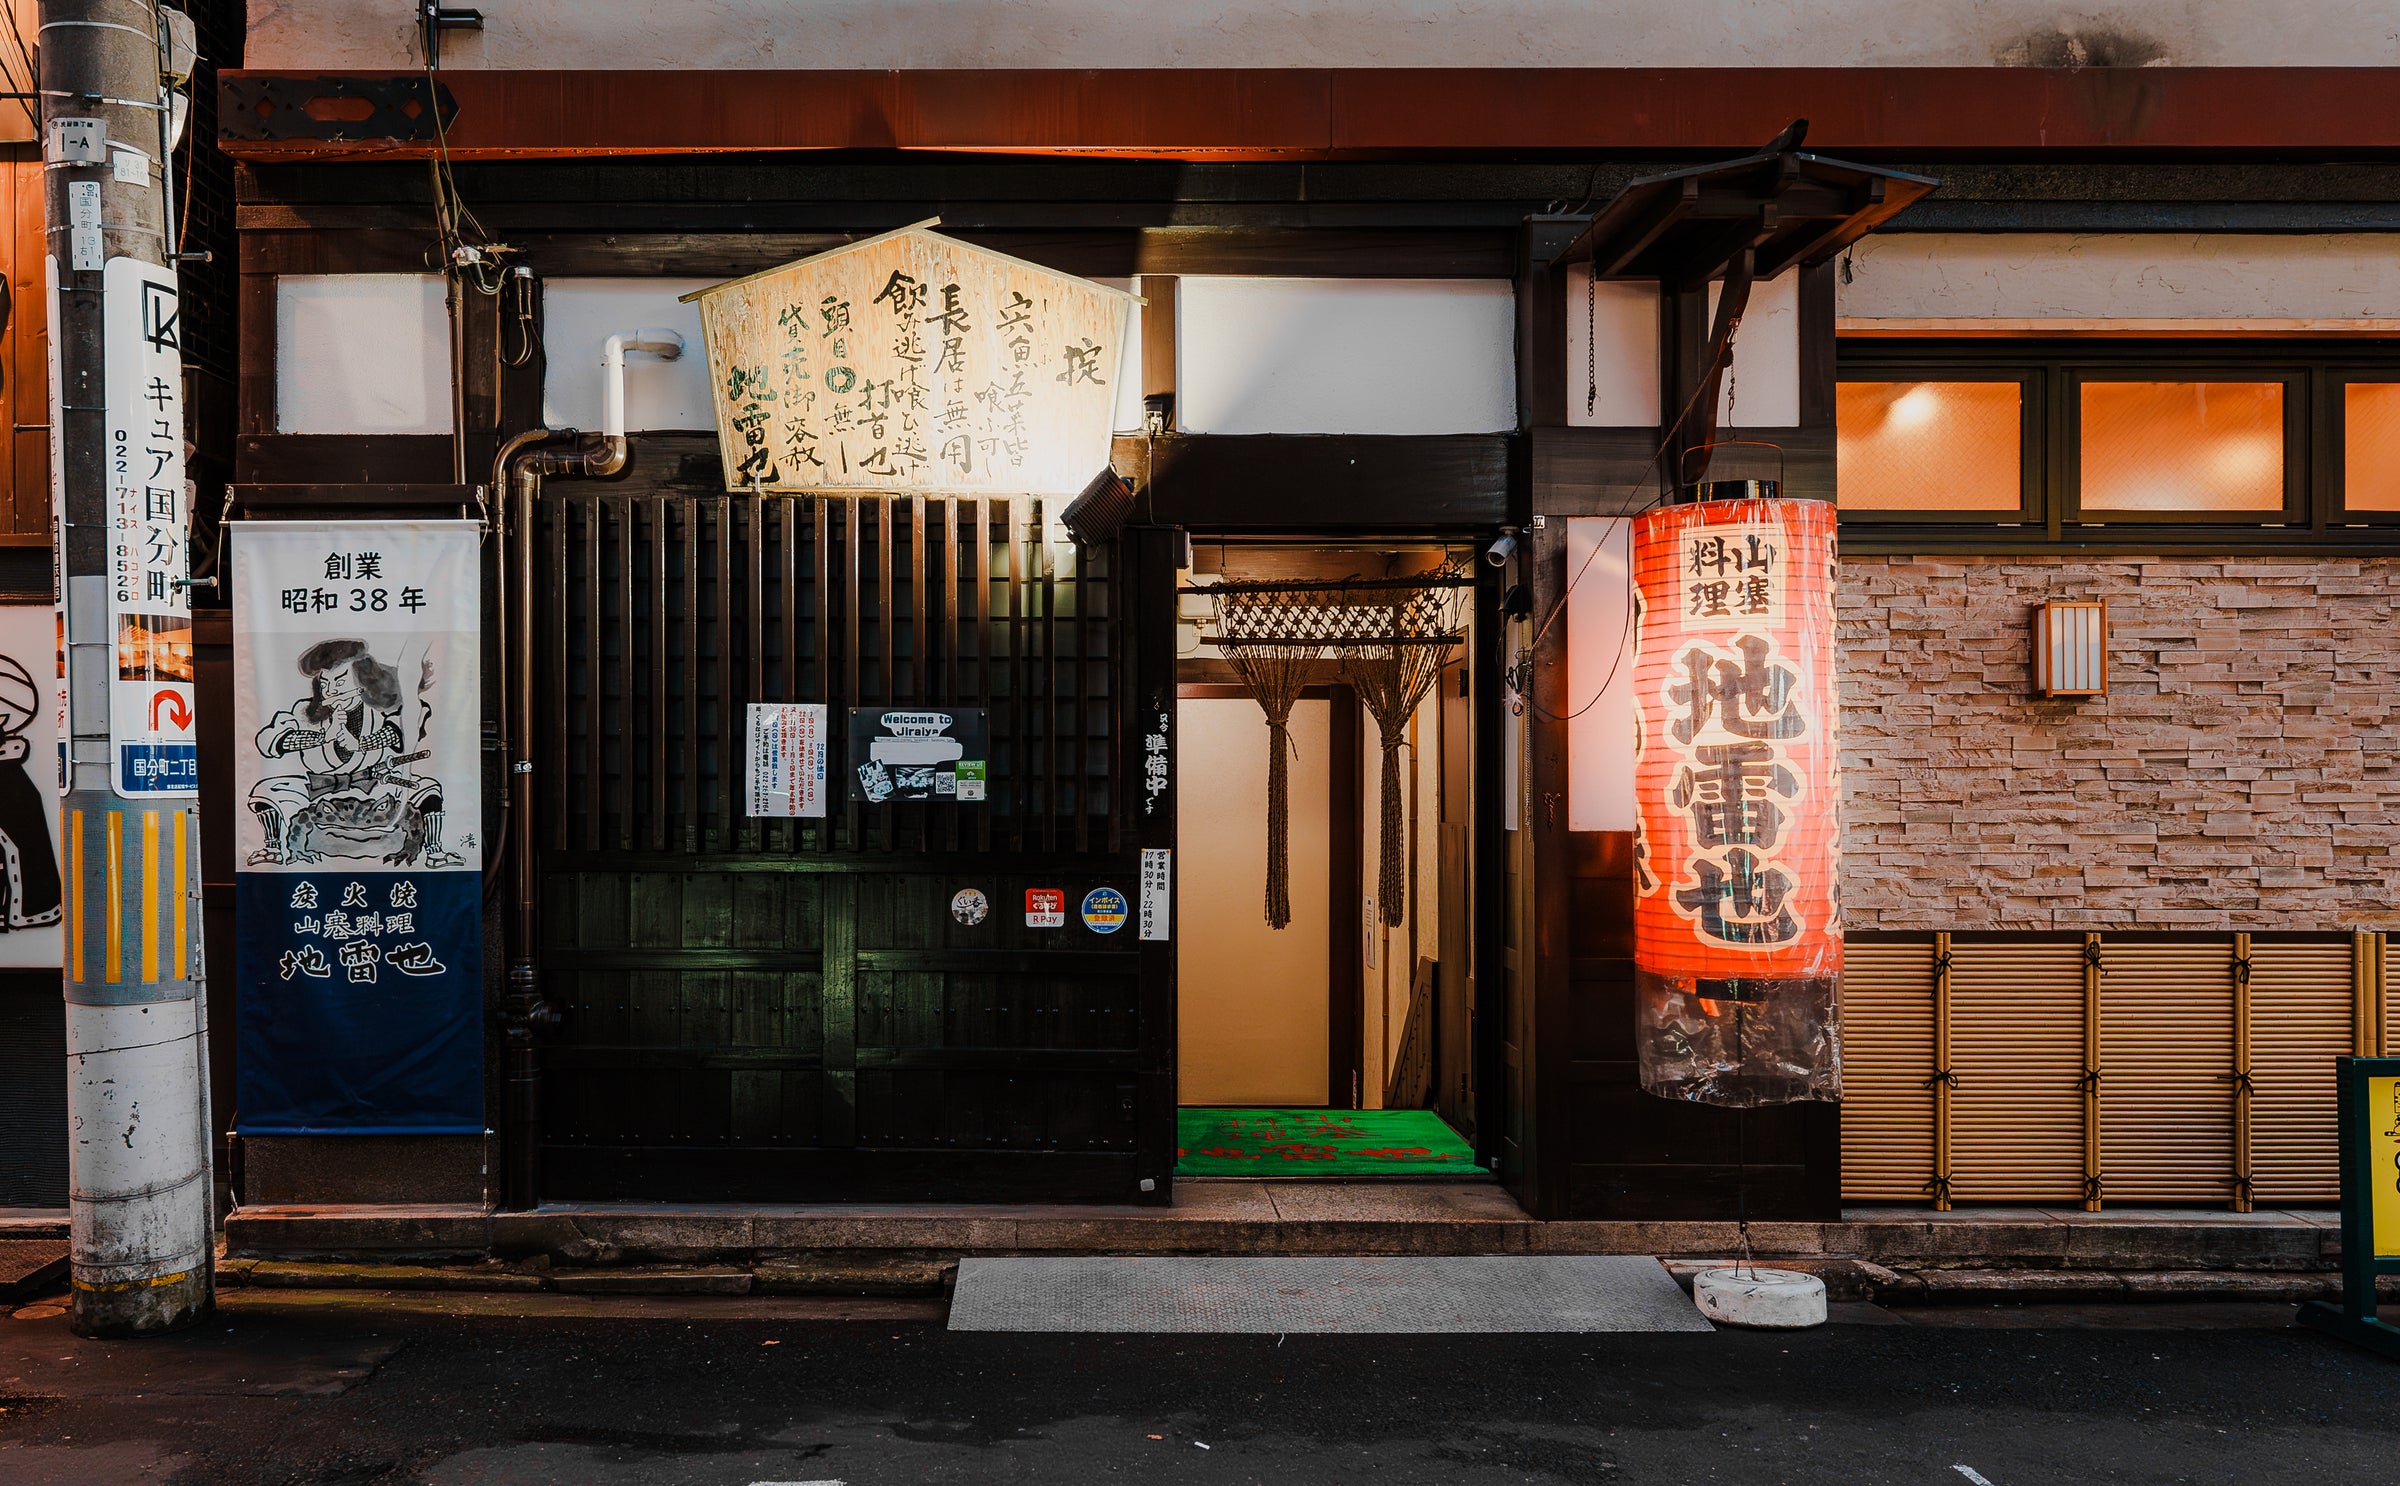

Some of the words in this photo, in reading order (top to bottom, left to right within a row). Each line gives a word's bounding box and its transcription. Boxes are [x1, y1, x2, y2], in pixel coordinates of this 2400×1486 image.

[80, 196, 93, 230] 国分町
[925, 282, 972, 475] 長居は無用
[1055, 336, 1106, 387] 掟
[726, 364, 781, 486] 地雷也
[129, 487, 138, 529] ナイス
[324, 551, 384, 582] 創業
[1688, 535, 1731, 618] 料理
[1730, 533, 1778, 616] 山塞
[280, 586, 338, 615] 昭和
[350, 587, 389, 614] 38
[398, 585, 428, 615] 年
[883, 714, 934, 724] Welcome
[939, 714, 953, 724] to
[896, 726, 939, 737] Jiraiya
[1145, 733, 1169, 797] 準備中
[1668, 633, 1806, 946] 地雷也
[1156, 851, 1166, 892] 営業時間
[1032, 893, 1058, 902] Rakuten
[1089, 896, 1121, 904] インボイス
[294, 909, 416, 940] 山塞料理
[1040, 915, 1058, 924] Pay
[278, 939, 447, 984] 地雷也
